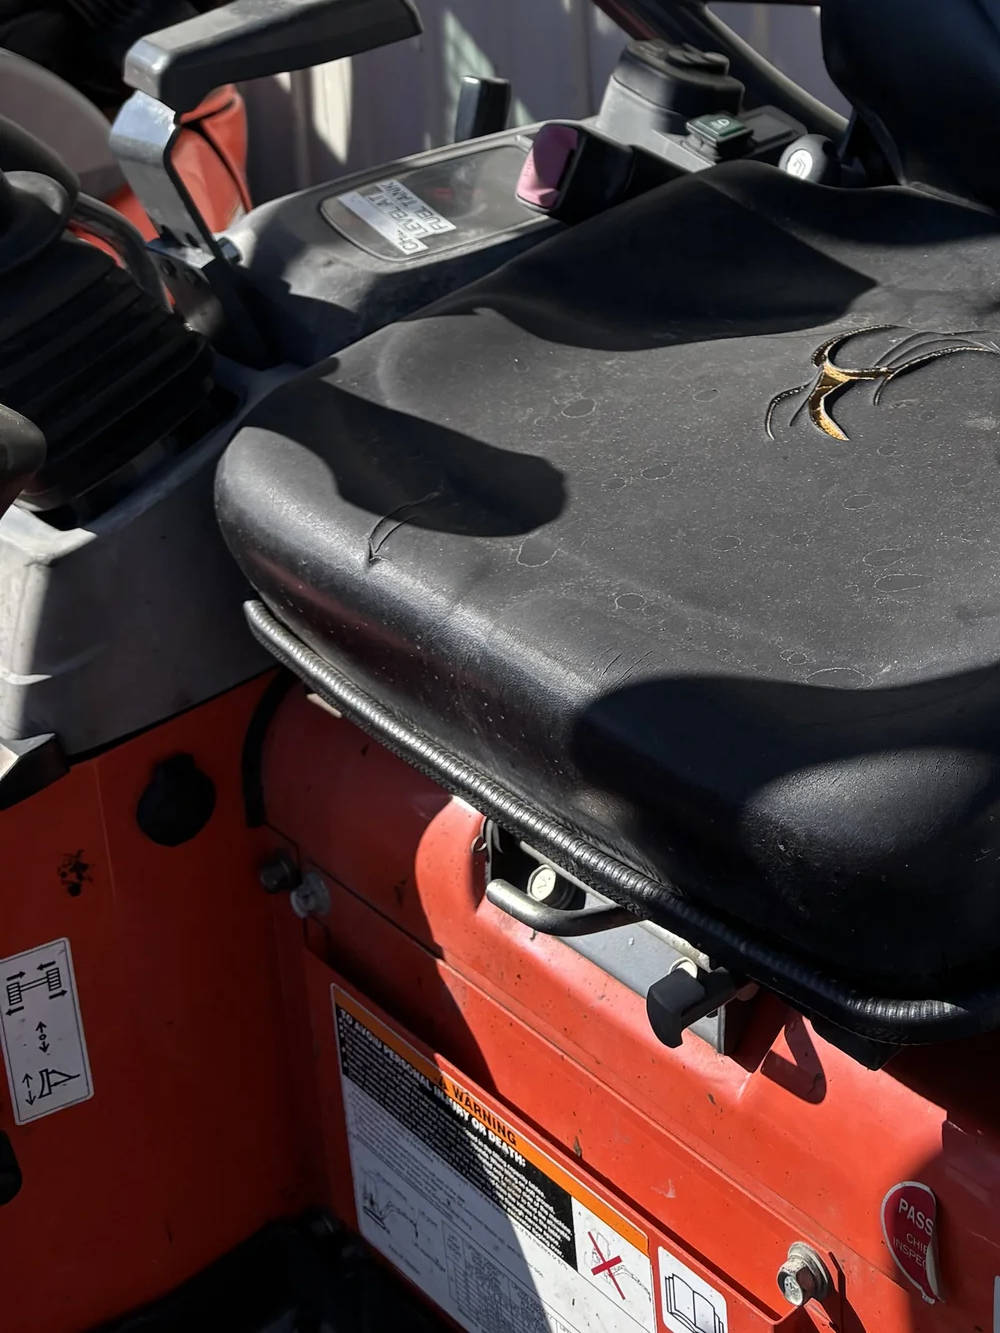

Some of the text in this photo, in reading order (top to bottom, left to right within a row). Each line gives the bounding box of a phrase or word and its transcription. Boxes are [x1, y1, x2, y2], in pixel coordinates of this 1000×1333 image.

[339, 1009, 353, 1025] TO
[353, 1020, 383, 1050] AVOID
[381, 1044, 433, 1091] PERSONAL
[431, 1085, 470, 1121] INJURY
[469, 1115, 489, 1136] OR
[486, 1130, 527, 1168] DEATH:
[451, 1084, 517, 1147] WARNING
[898, 1197, 934, 1236] PASS
